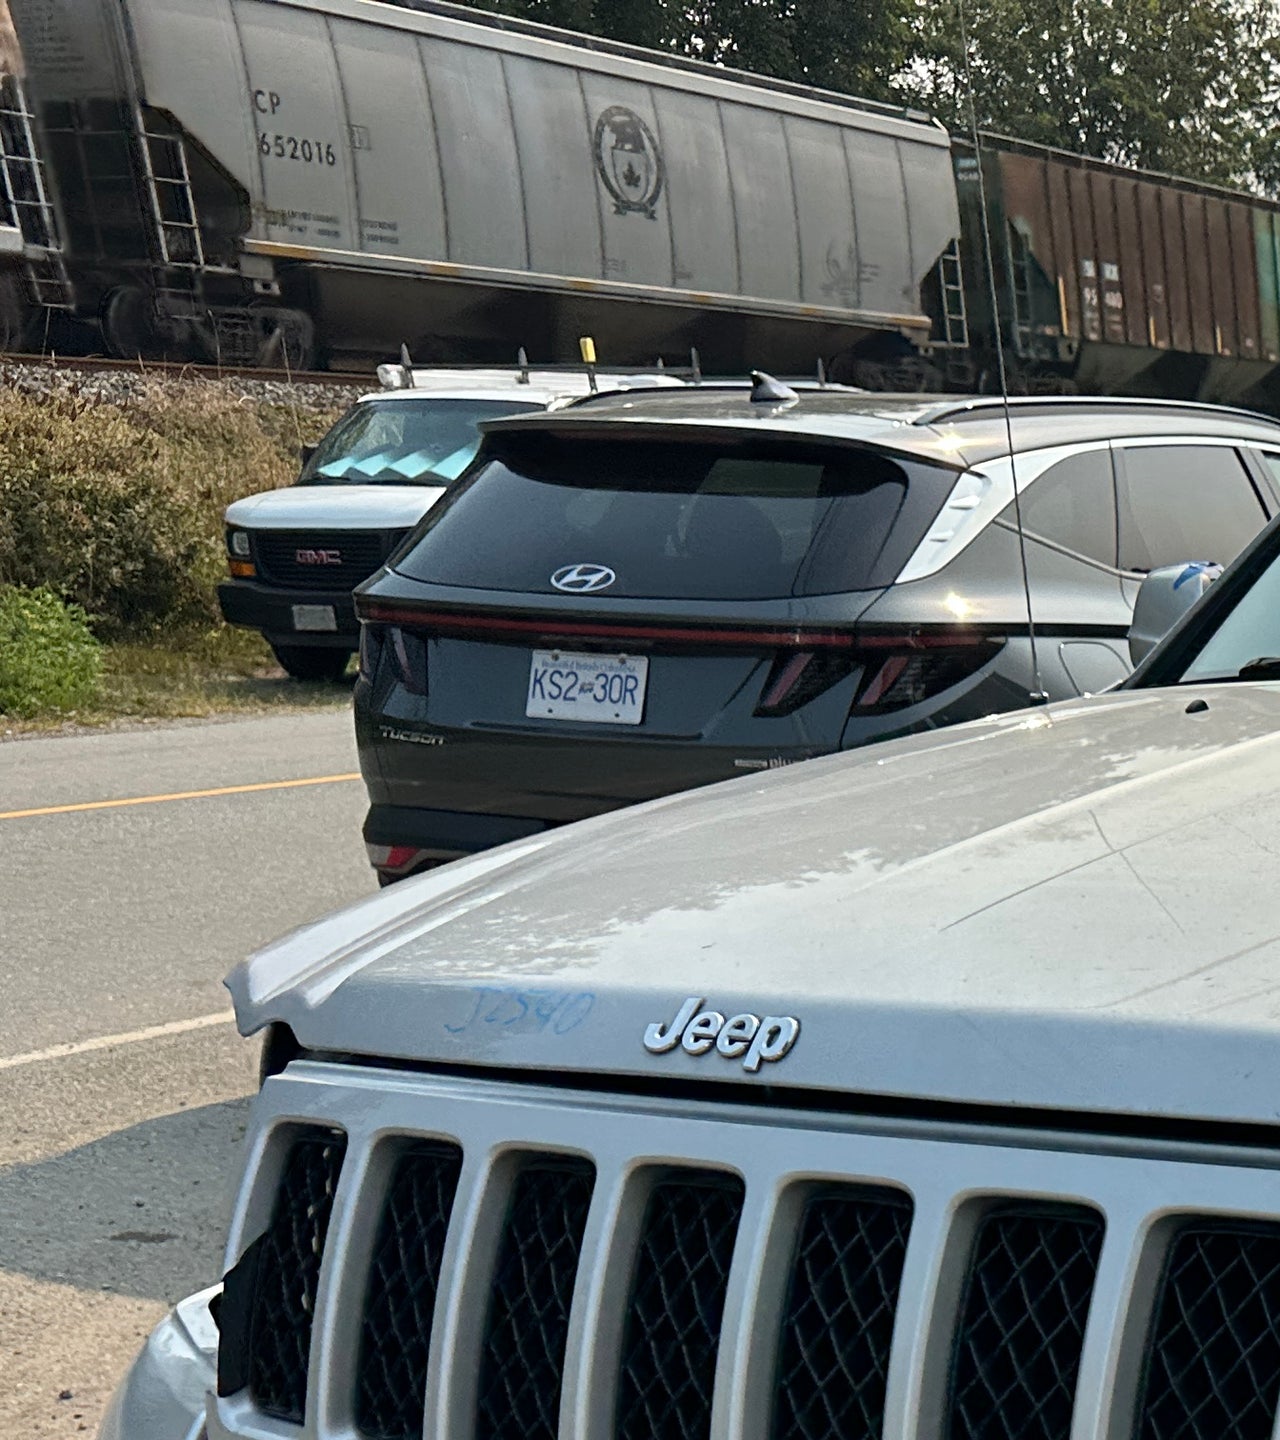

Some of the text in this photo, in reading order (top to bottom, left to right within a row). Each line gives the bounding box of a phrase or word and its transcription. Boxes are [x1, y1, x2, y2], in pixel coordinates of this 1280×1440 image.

[254, 89, 281, 114] CP
[259, 132, 336, 166] 652016
[296, 549, 342, 565] GMC
[643, 997, 800, 1072] Jeep
